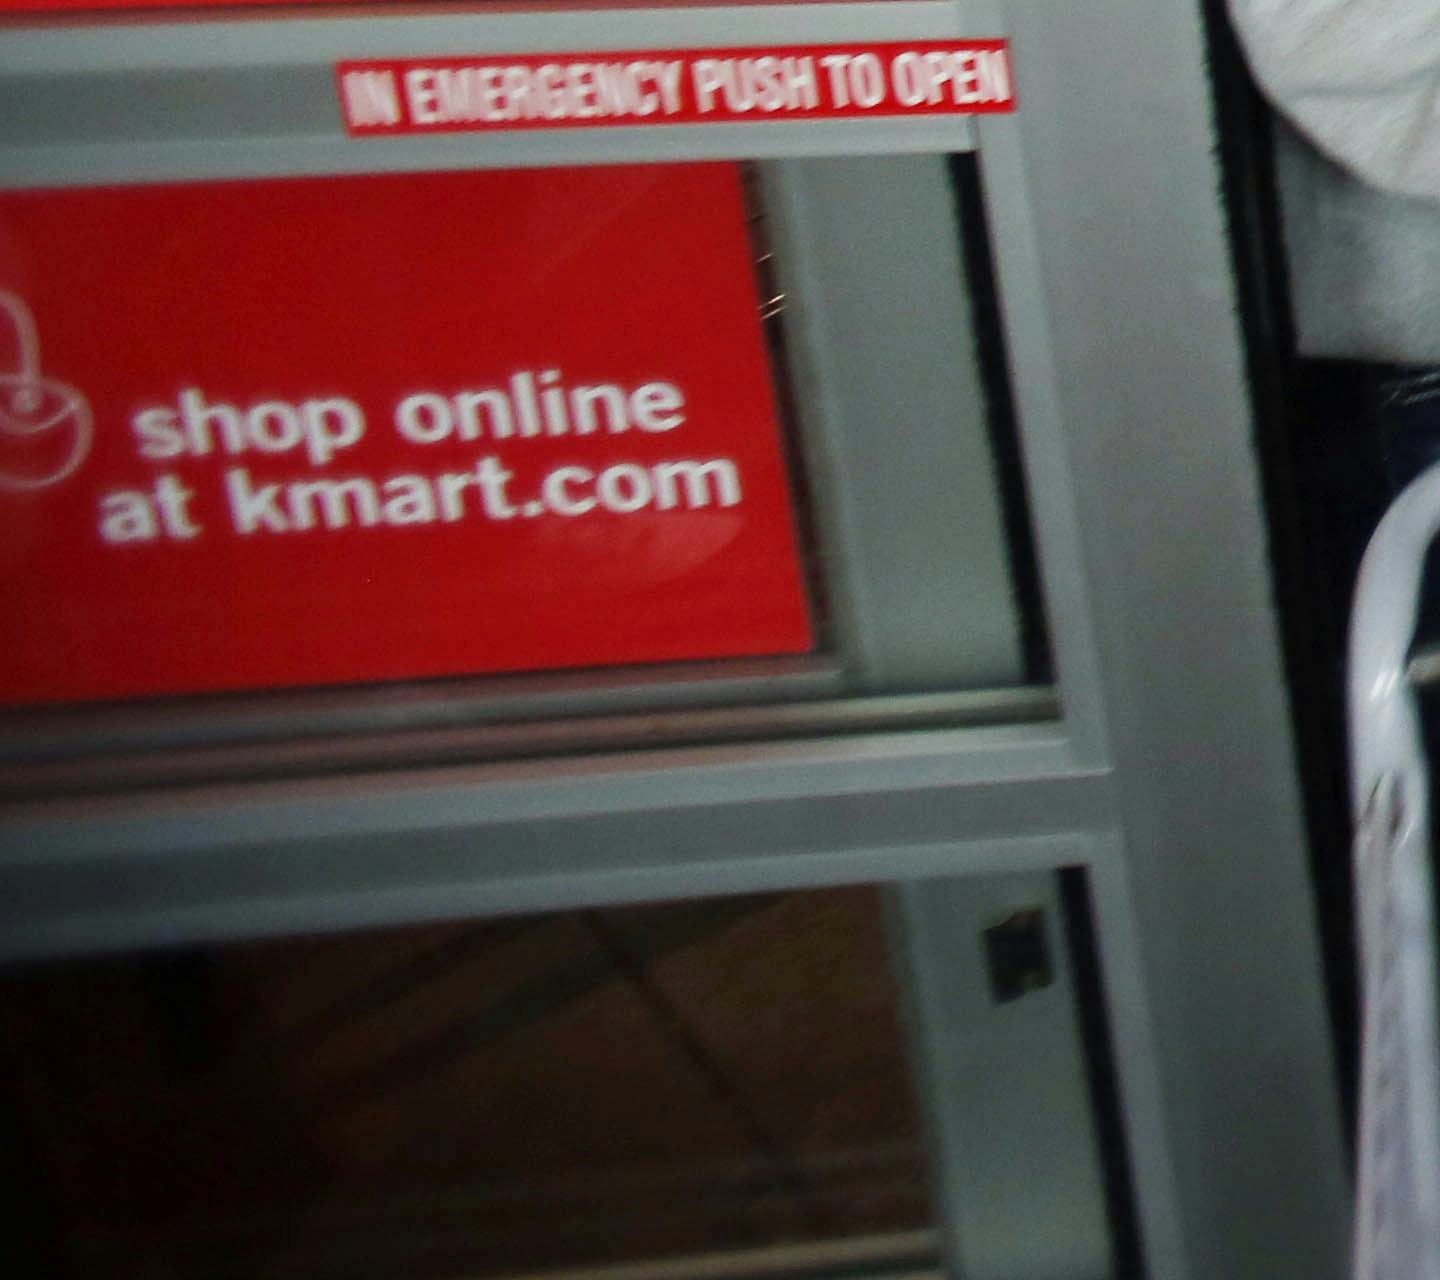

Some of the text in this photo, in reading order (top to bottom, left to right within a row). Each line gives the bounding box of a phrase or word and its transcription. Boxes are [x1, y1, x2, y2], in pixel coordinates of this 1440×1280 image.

[348, 48, 1010, 128] IN EMERGENCY PUSH TO OPEN
[132, 370, 686, 464] shop online
[100, 452, 742, 544] at kmart.com
